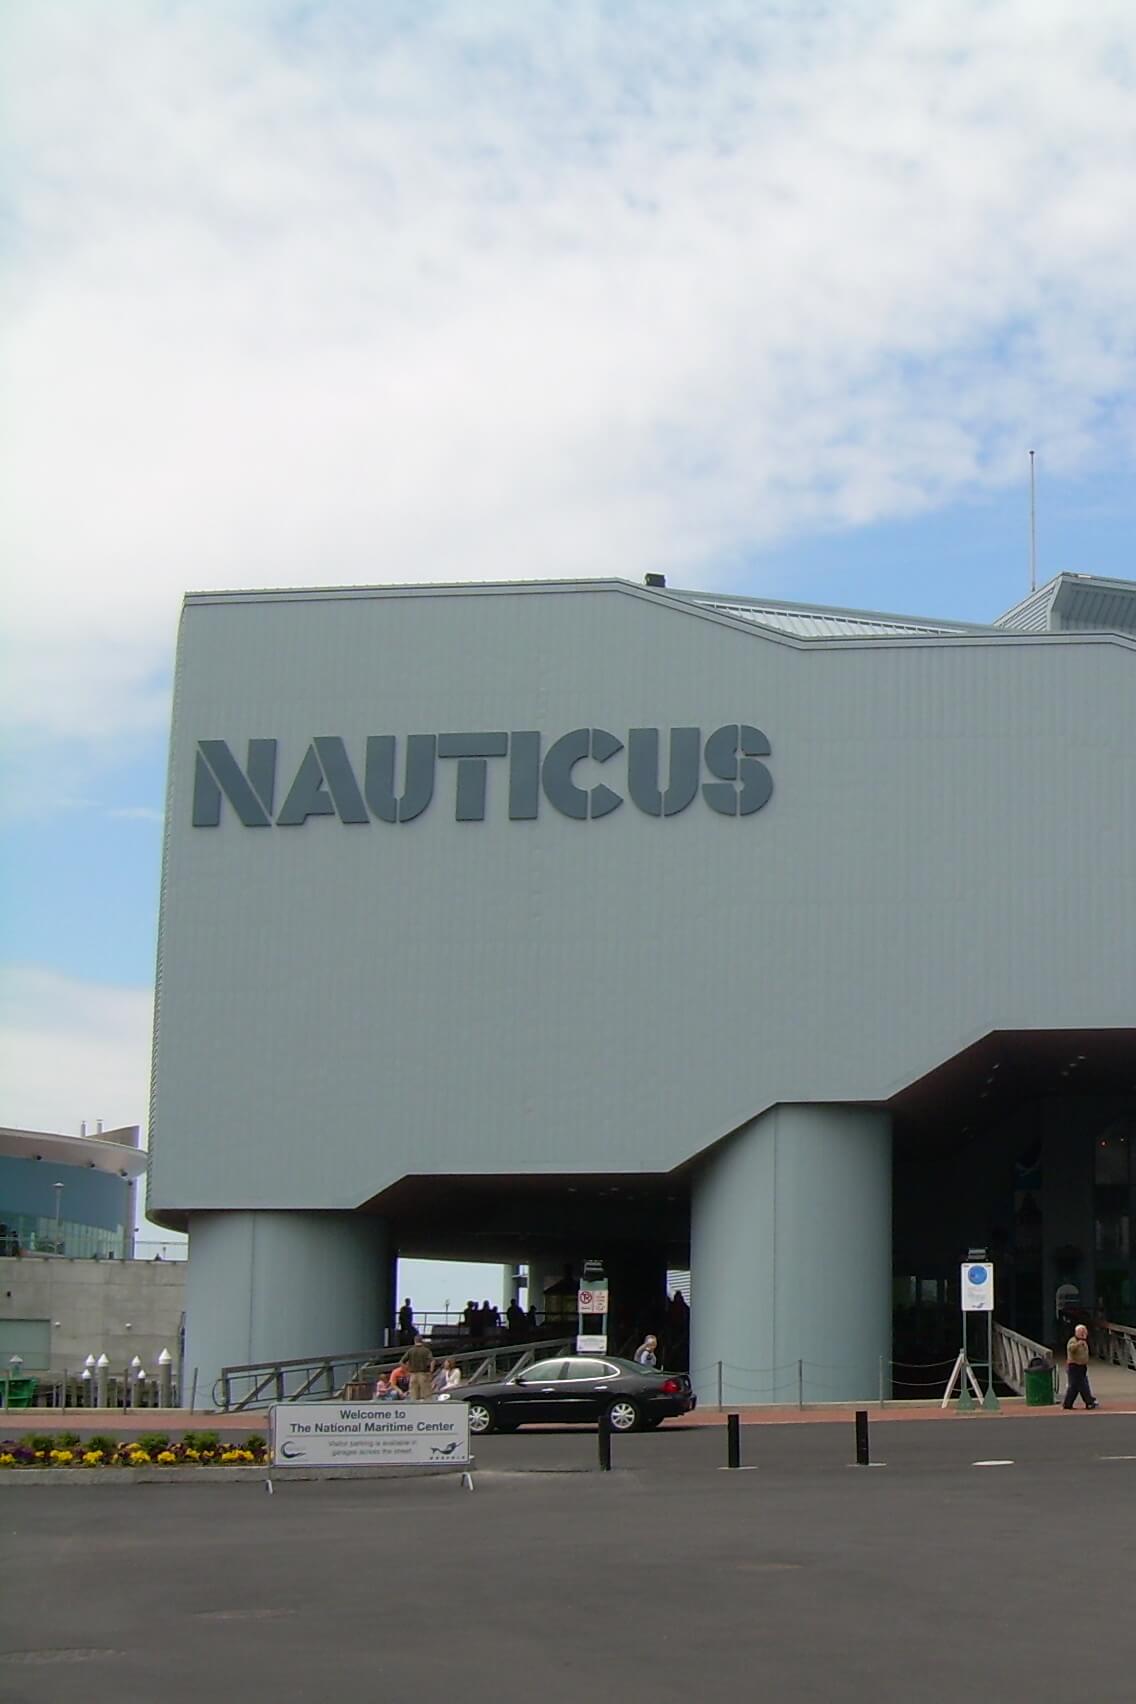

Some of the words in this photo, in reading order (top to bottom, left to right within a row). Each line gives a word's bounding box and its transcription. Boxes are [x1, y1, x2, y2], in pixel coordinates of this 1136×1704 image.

[192, 724, 774, 827] NAUTICUS
[340, 1409, 392, 1419] Welcome
[395, 1409, 406, 1419] to
[290, 1423, 311, 1433] The
[315, 1422, 361, 1433] National
[364, 1421, 413, 1432] Maritime
[417, 1421, 455, 1431] Center
